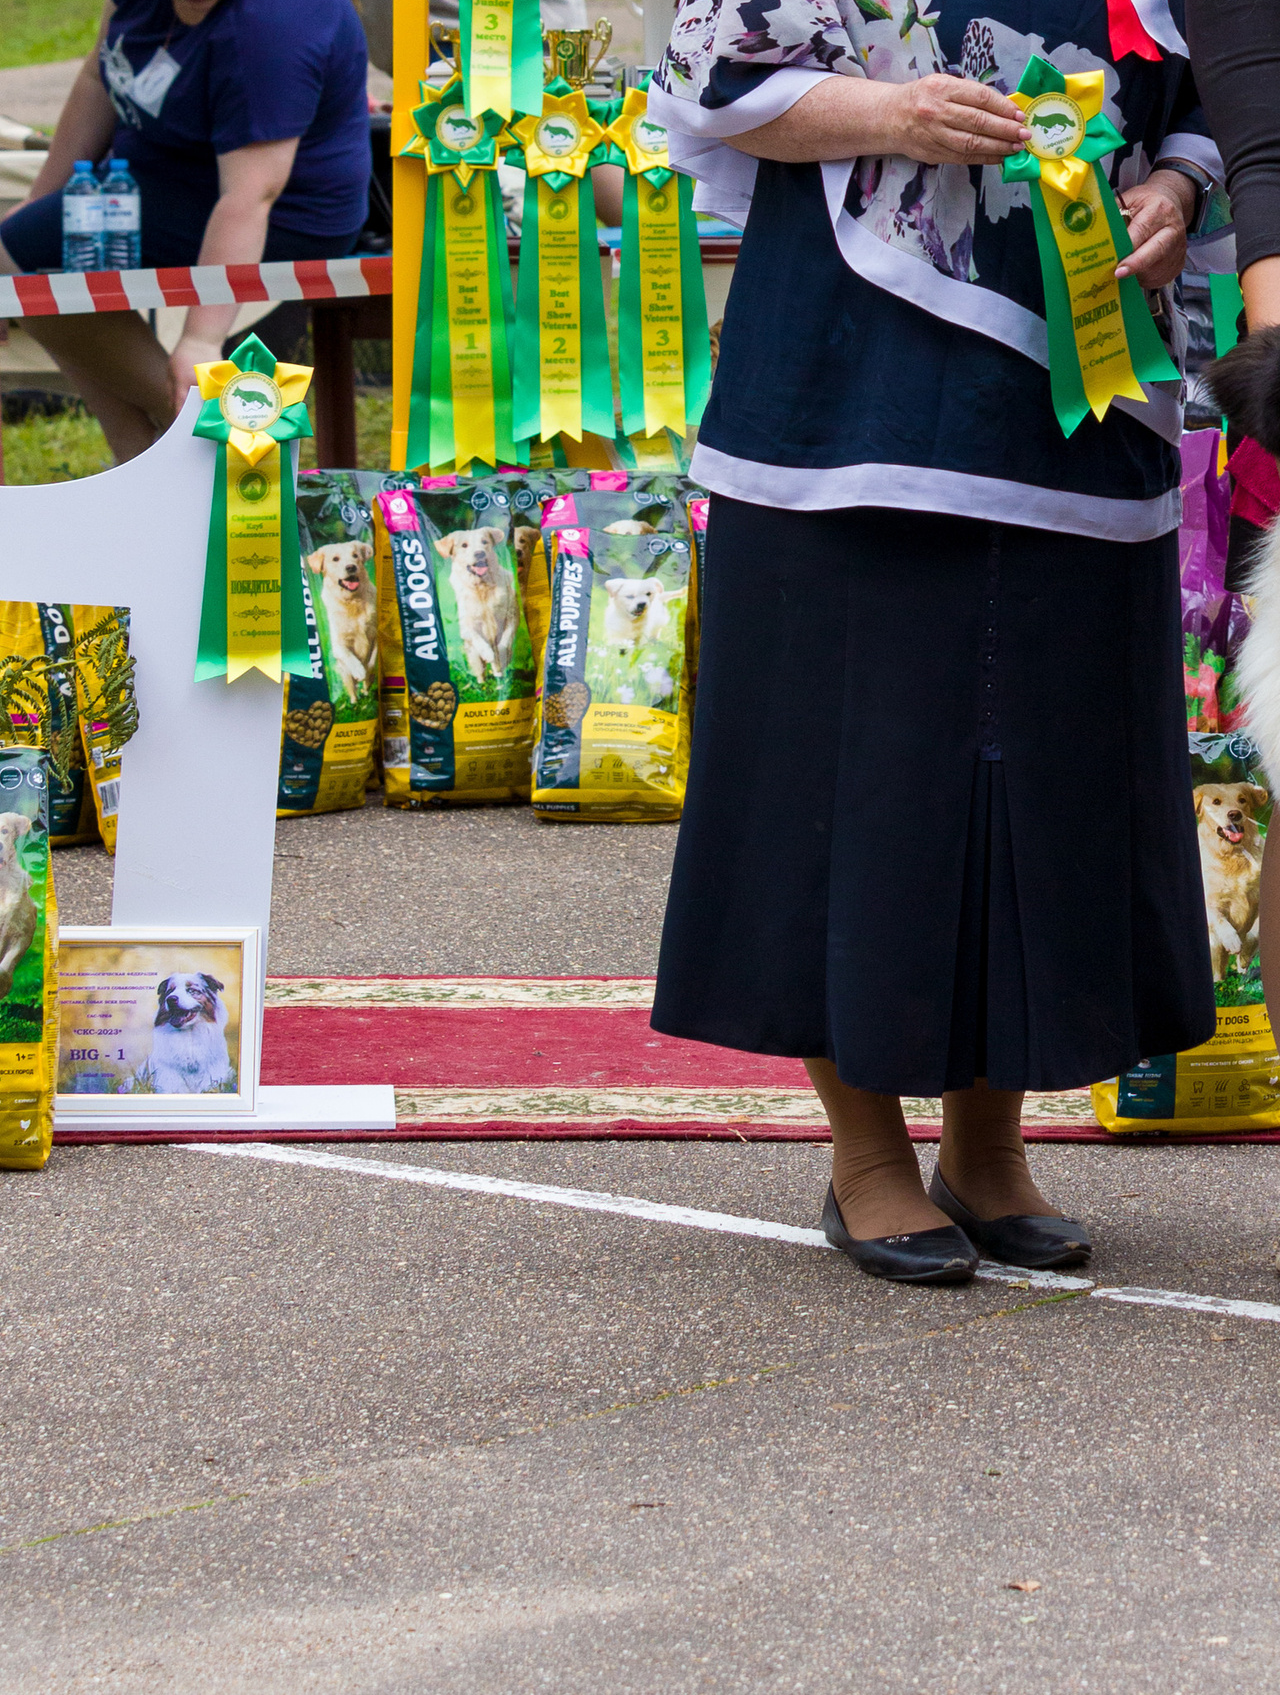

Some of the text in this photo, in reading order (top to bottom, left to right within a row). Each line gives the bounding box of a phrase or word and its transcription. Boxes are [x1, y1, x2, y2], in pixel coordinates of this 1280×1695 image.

[484, 13, 499, 31] 3
[476, 33, 507, 41] место
[1042, 135, 1074, 150] САФОНОВО
[458, 285, 479, 293] Best
[651, 281, 671, 291] Best
[549, 290, 571, 298] Best
[656, 292, 667, 301] In
[463, 296, 474, 304] In
[554, 300, 565, 308] In
[455, 306, 482, 315] Show
[648, 303, 675, 312] Show
[546, 311, 573, 320] Show
[644, 314, 681, 324] Veteran
[1074, 299, 1119, 330] ПОБЕДИТЕЛЬ
[452, 317, 489, 326] Veteran
[541, 322, 578, 331] Veteran
[463, 332, 479, 350] 1
[655, 329, 670, 347] 3
[552, 337, 568, 355] 2
[648, 349, 679, 357] место
[246, 522, 264, 531] Клуб
[402, 538, 433, 609] DOGS
[230, 579, 281, 597] ПОБЕДИТЕЛЬ
[557, 560, 584, 667] ALL PUPPIES
[46, 602, 70, 644] DO
[240, 629, 281, 638] Сафоново
[413, 613, 439, 661] ALL
[308, 631, 323, 679] ALL
[464, 707, 511, 718] ADULT DOGS
[594, 710, 629, 718] PUPPIES
[1225, 1015, 1250, 1026] DOGS
[69, 1048, 100, 1061] BIG
[117, 1048, 126, 1061] 1
